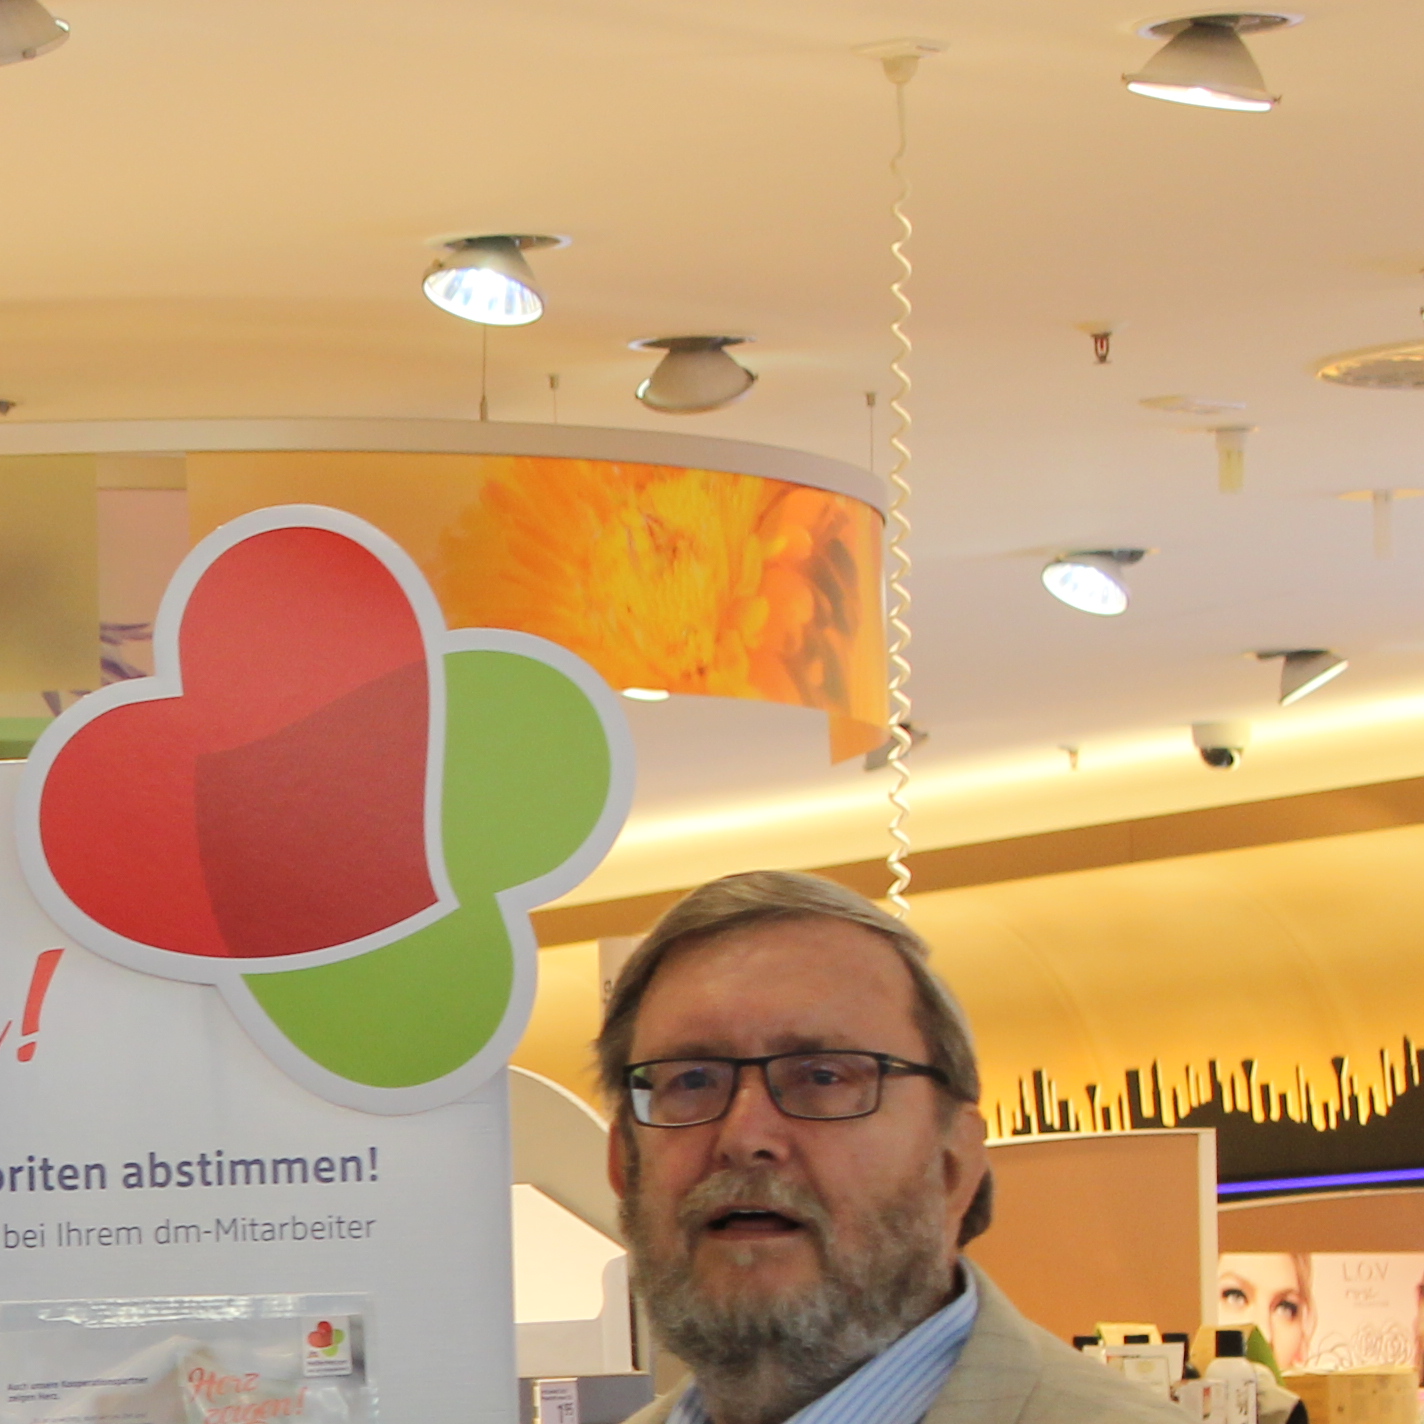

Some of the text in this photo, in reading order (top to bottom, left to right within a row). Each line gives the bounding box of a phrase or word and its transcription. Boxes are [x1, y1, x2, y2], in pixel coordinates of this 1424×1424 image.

[122, 1147, 381, 1190] abstimmen!
[4, 1222, 45, 1250] bei
[58, 1219, 143, 1249] Ihrem
[155, 1213, 375, 1244] dm-Mitarbeiter
[188, 1367, 261, 1404] Herz
